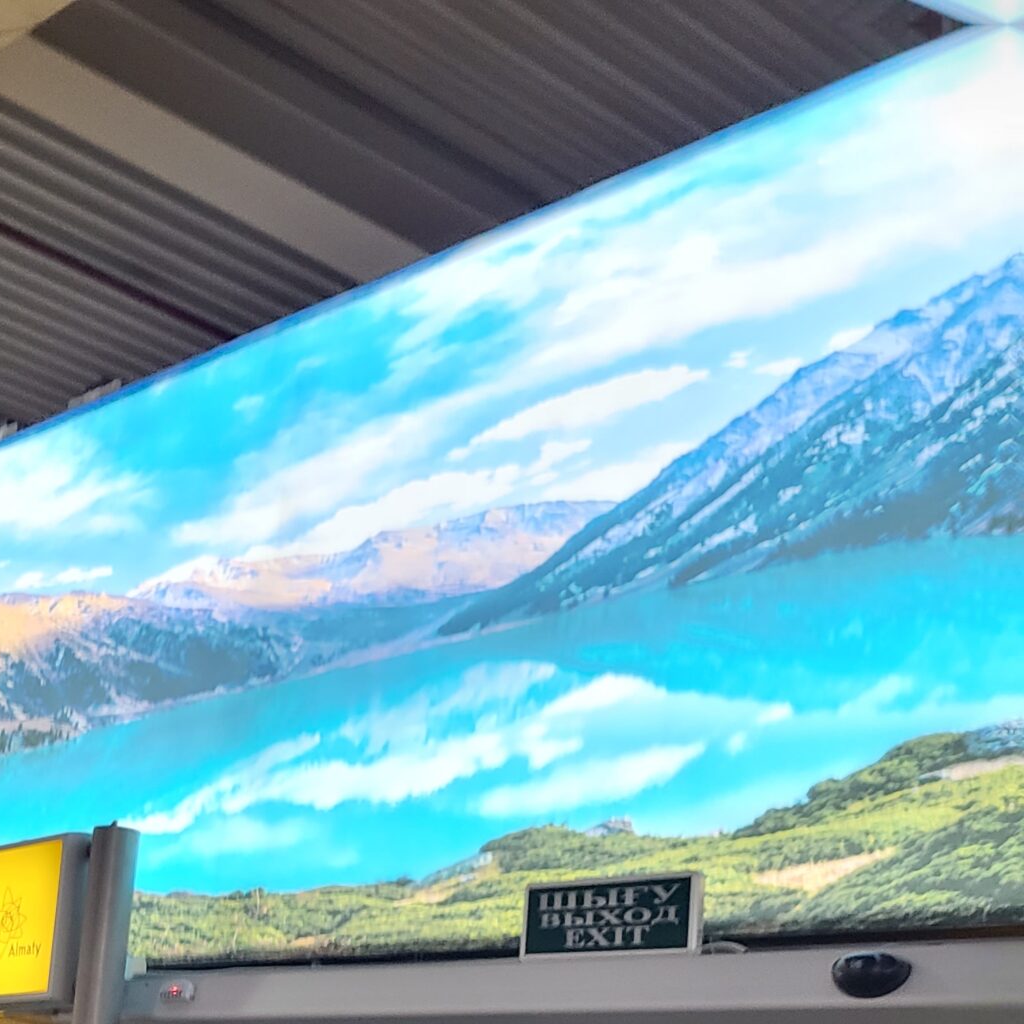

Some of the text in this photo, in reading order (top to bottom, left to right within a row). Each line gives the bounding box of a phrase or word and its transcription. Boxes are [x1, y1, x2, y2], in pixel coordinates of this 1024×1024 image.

[540, 905, 680, 929] ВЫХОД
[564, 925, 651, 948] EXIT
[8, 941, 41, 958] Almaty
